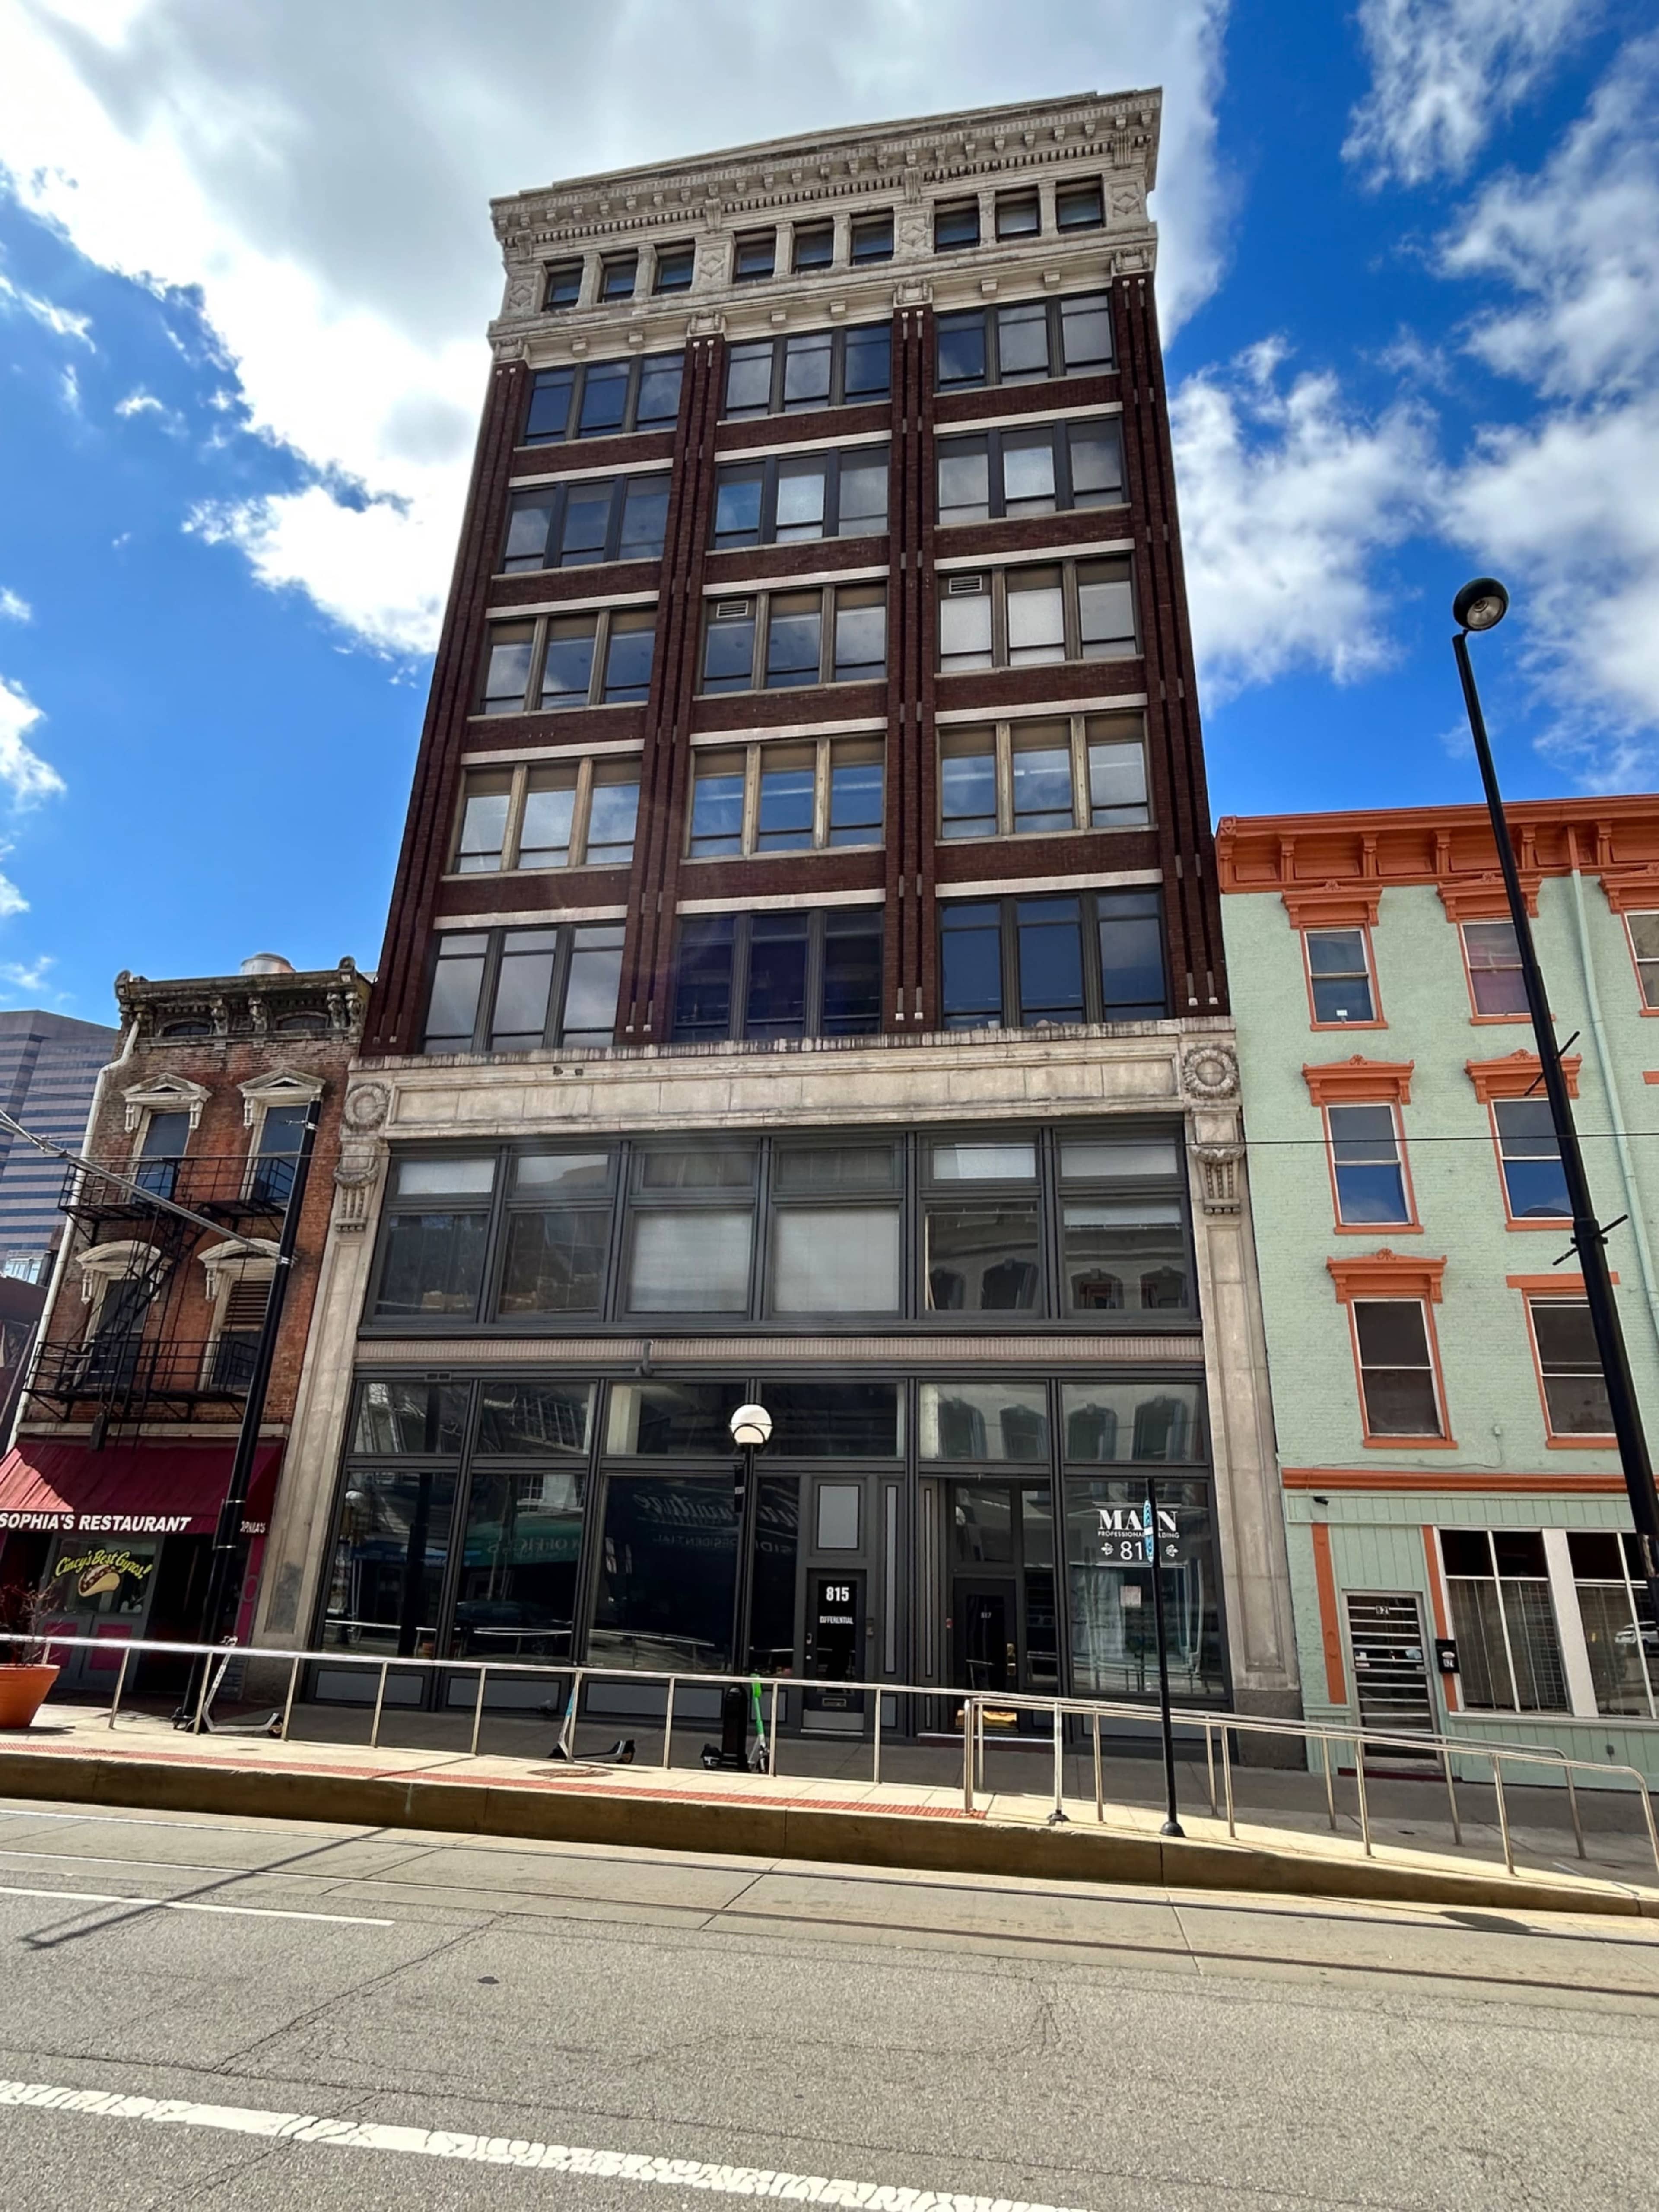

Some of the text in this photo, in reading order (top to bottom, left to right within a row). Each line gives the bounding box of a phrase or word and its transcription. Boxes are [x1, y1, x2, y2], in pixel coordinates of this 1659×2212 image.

[0, 1513, 191, 1532] SOPHIA'S RESTAURANT
[1097, 1509, 1178, 1532] MAN
[1120, 1541, 1143, 1560] 81
[55, 1549, 153, 1579] Cincy's Best Gyros!
[826, 1586, 849, 1601] 815
